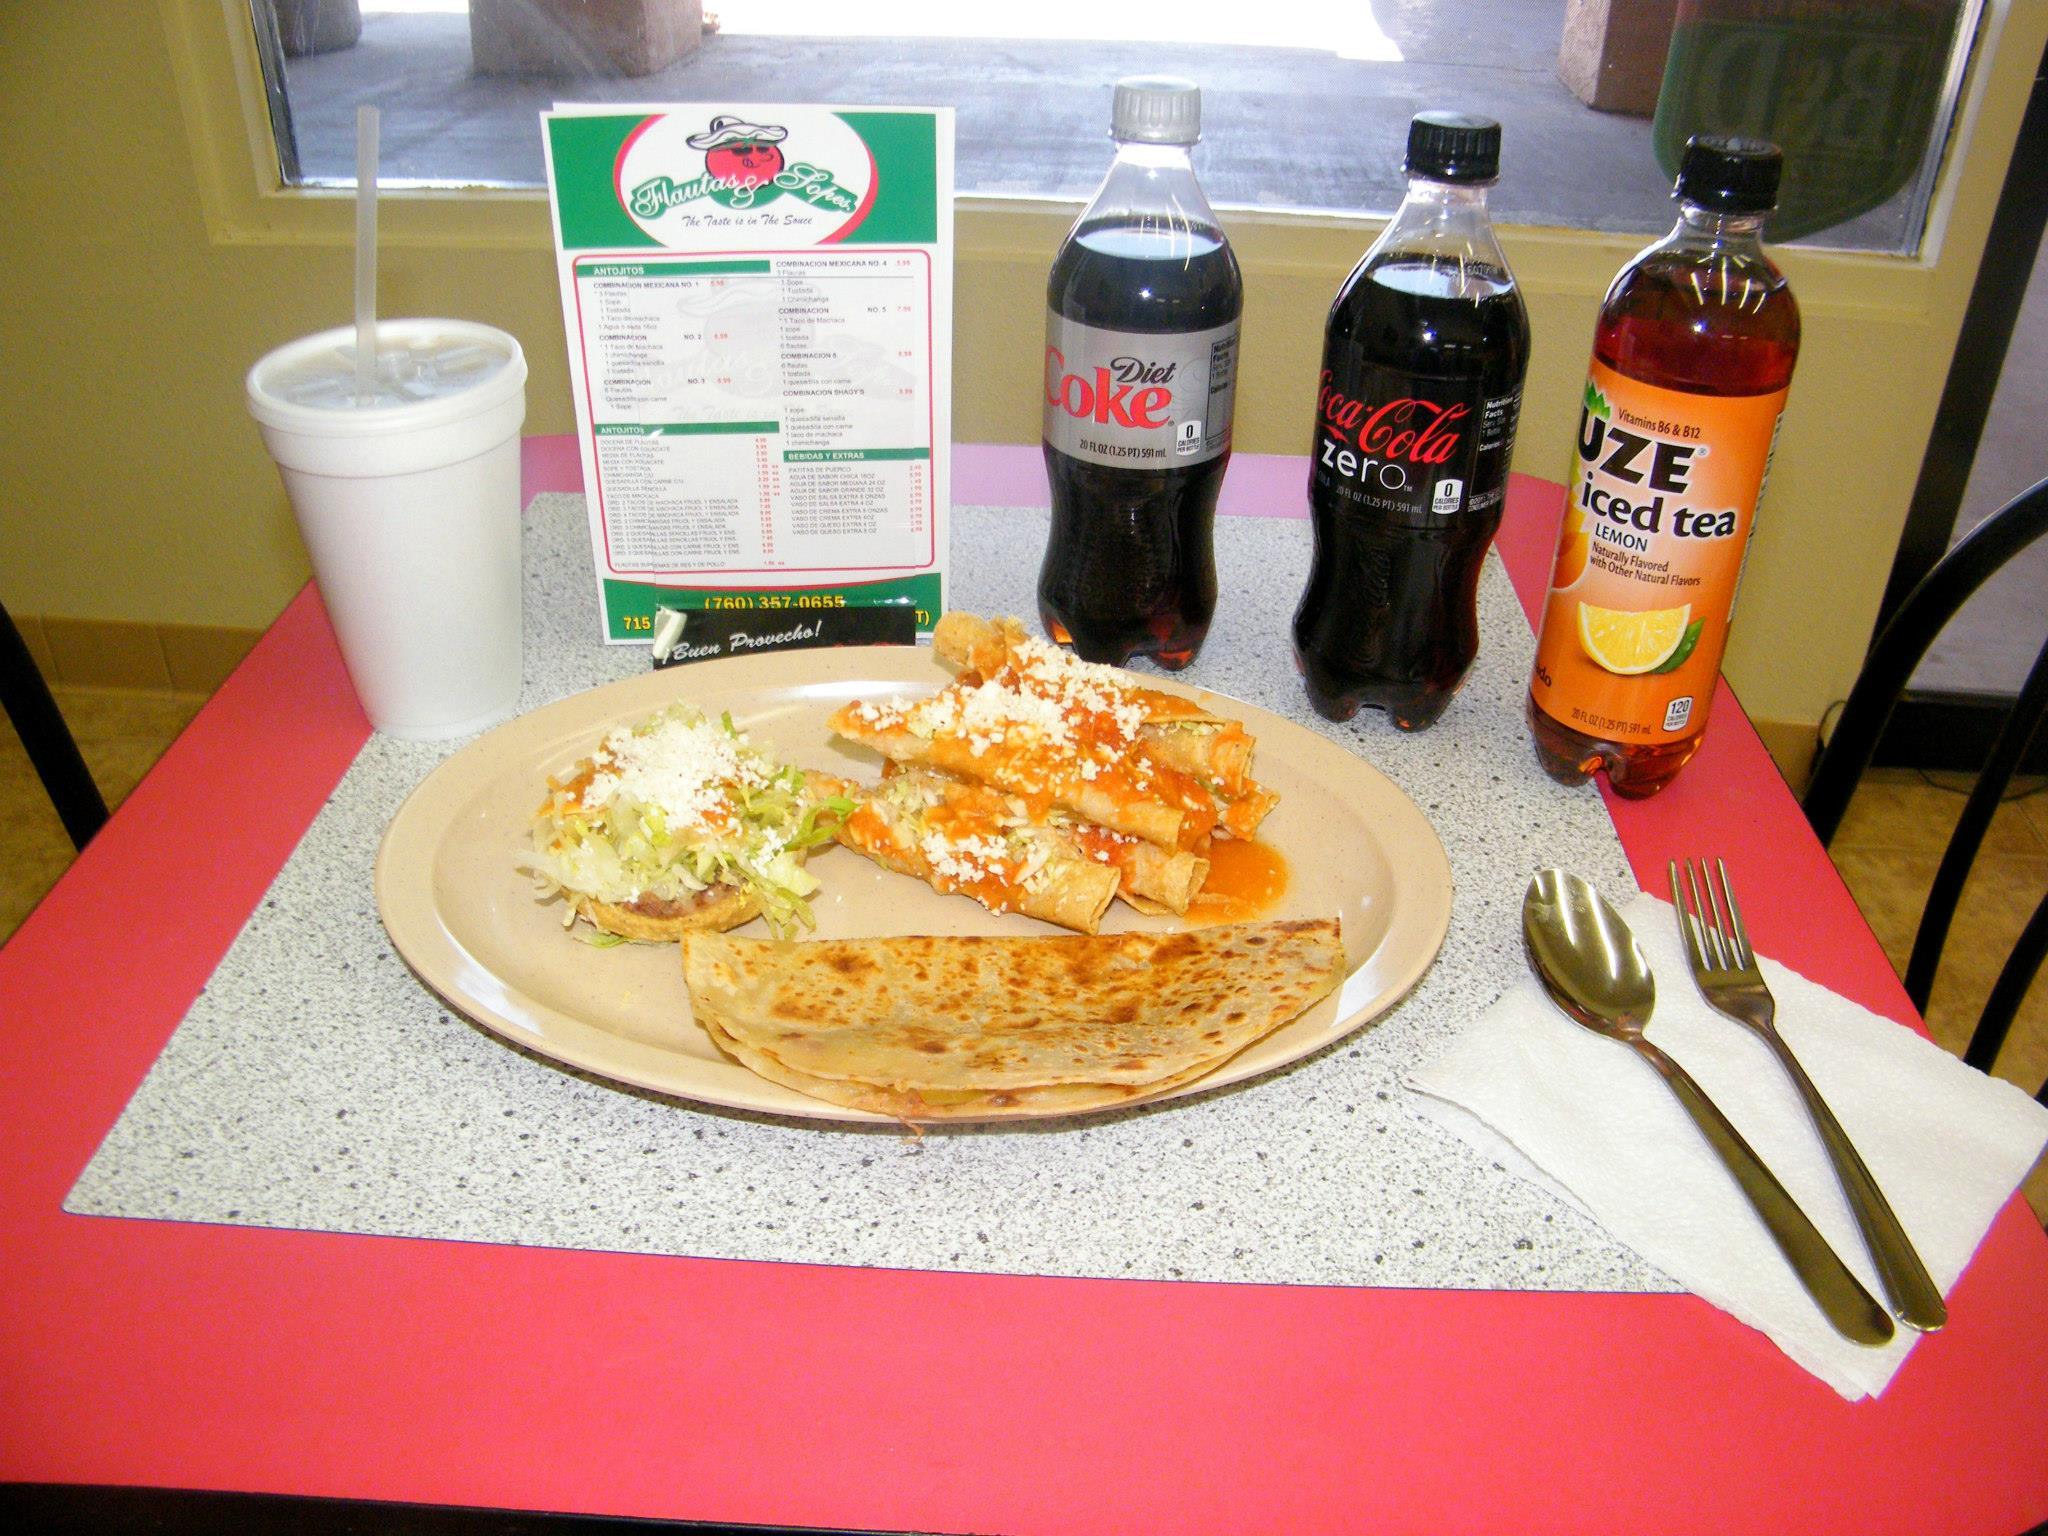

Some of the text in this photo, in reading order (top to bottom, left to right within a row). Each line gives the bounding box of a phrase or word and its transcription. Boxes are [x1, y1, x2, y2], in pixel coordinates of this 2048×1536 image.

[634, 171, 740, 216] Flautas
[730, 176, 769, 209] &
[682, 215, 702, 227] The
[704, 214, 732, 226] Taste
[736, 214, 744, 226] is
[747, 214, 758, 225] in
[761, 214, 781, 225] The
[593, 266, 645, 276] ANTOJITOS
[1110, 356, 1177, 384] Diet
[1045, 345, 1173, 429] Coke
[1186, 424, 1194, 439] 0
[1618, 407, 1701, 439] Vitamins B6 & B12
[1080, 439, 1088, 450] 20
[1089, 442, 1098, 453] FL
[1098, 444, 1108, 455] OZ
[1141, 448, 1154, 458] 591
[1155, 448, 1167, 458] mL
[1321, 439, 1406, 490] zero
[1444, 483, 1453, 497] 0
[1581, 470, 1736, 538] iced tea
[1396, 502, 1409, 512] 591
[1595, 522, 1648, 552] LEMON
[1590, 555, 1701, 586] with Other Natural Flavors
[1591, 541, 1669, 573] Naturally Flavored
[758, 594, 845, 609] 357-0655
[624, 617, 651, 631] 715
[729, 619, 823, 652] Provecho!
[1671, 700, 1690, 715] 120
